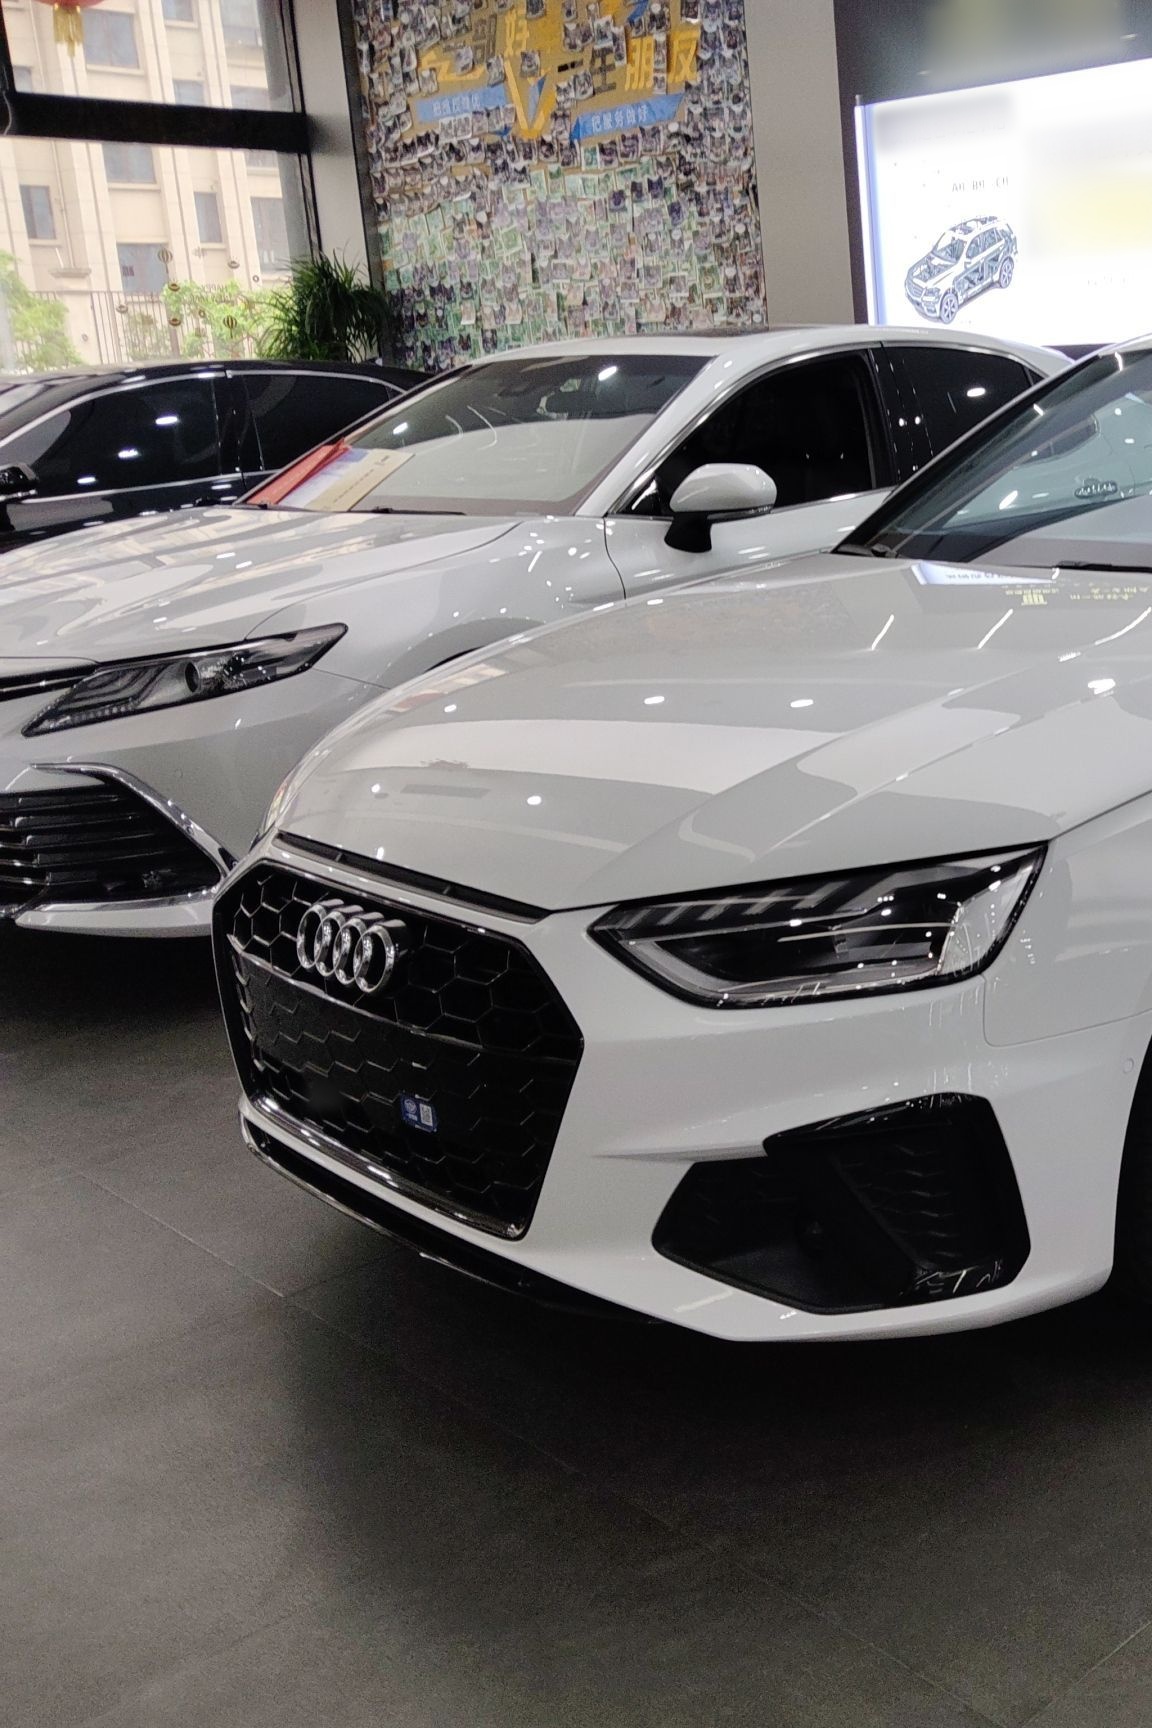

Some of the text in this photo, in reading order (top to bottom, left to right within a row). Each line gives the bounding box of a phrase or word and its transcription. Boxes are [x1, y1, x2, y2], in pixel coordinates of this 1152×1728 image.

[591, 108, 649, 134] 把服务做好
